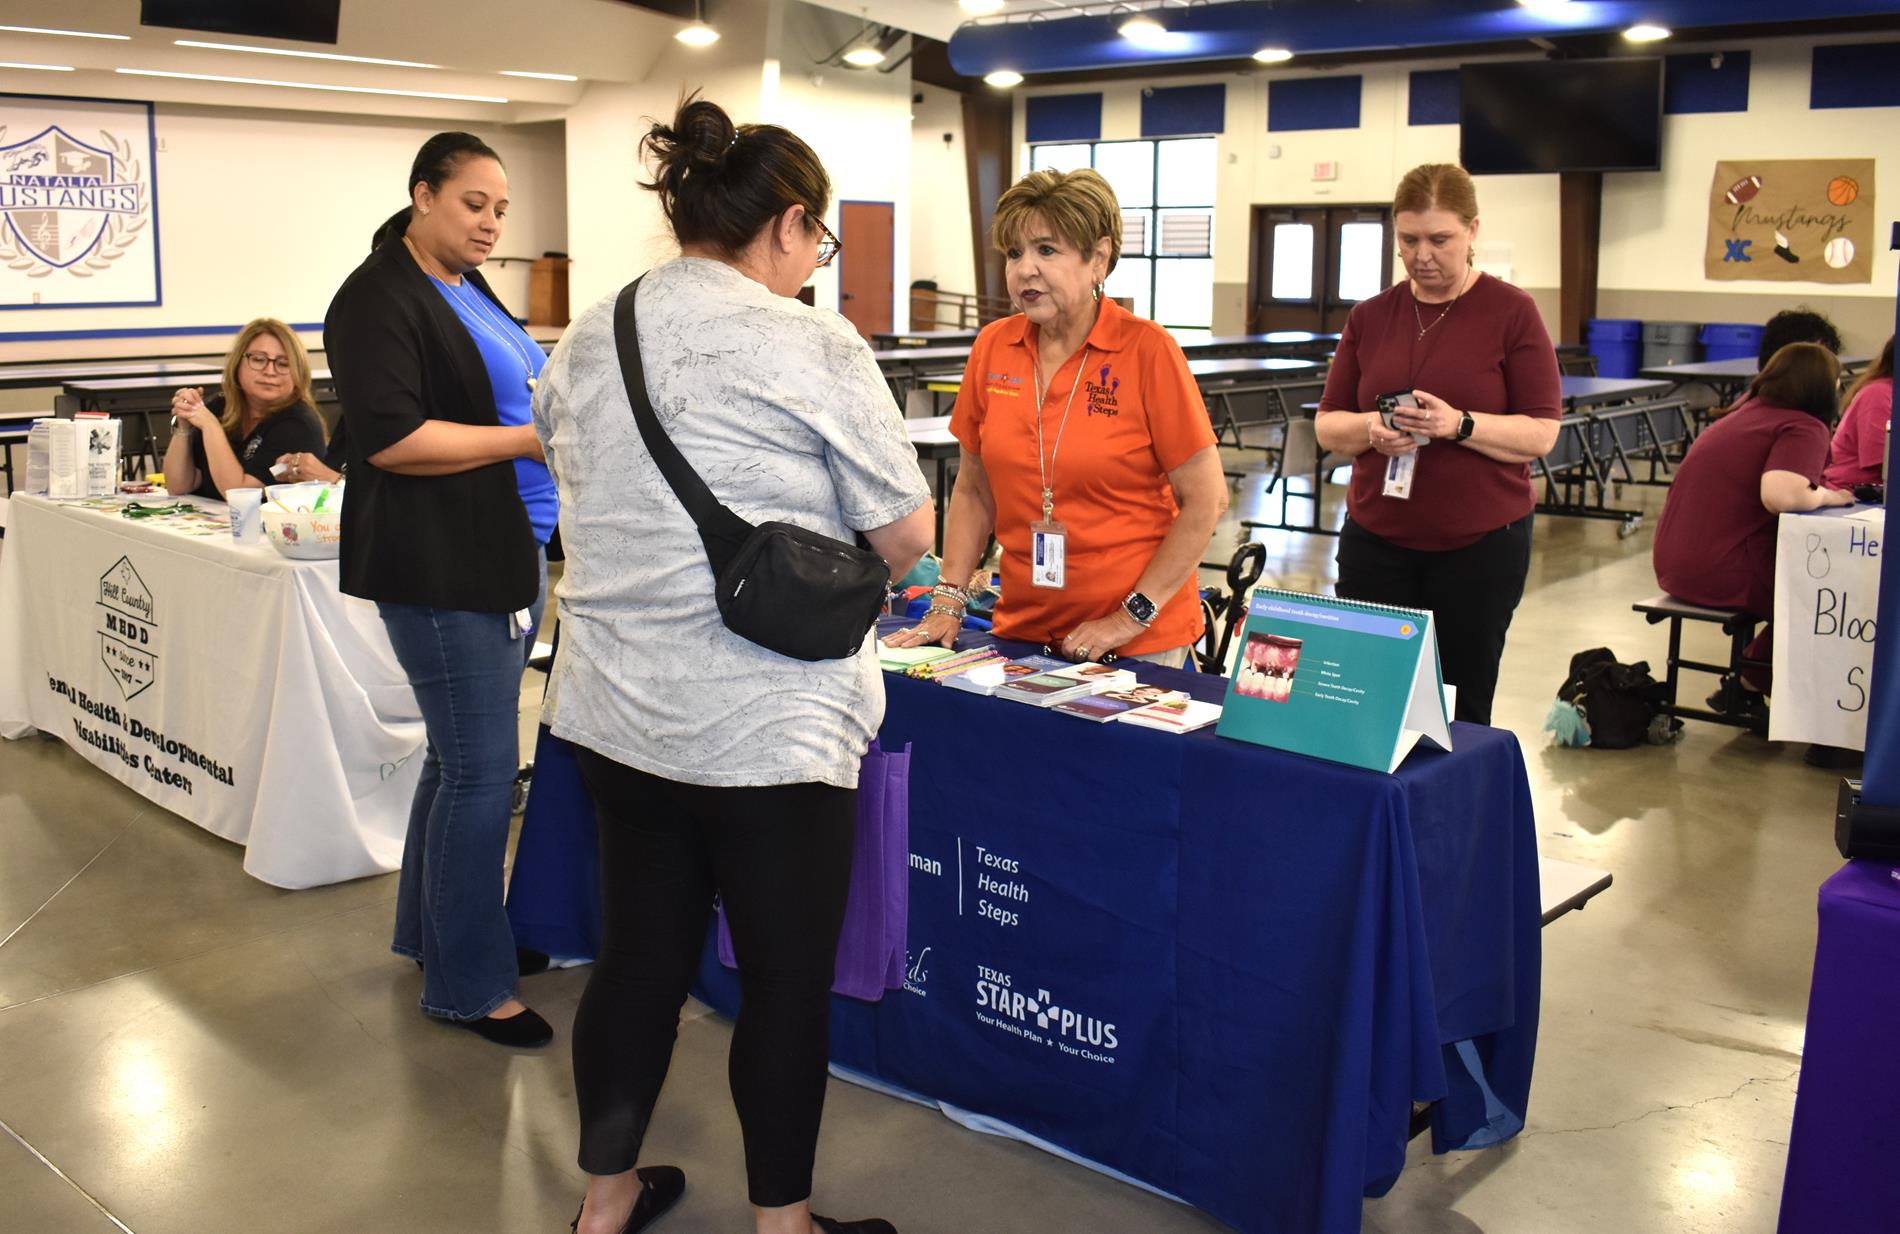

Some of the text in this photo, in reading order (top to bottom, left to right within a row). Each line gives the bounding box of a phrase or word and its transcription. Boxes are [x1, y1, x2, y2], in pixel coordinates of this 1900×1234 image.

[12, 175, 100, 188] NATALIA
[0, 186, 135, 210] USTANGS
[1732, 204, 1852, 243] Mustangs
[1723, 239, 1752, 263] XC
[1085, 381, 1110, 395] Texas
[1088, 392, 1118, 406] Health
[1093, 404, 1119, 417] Steps
[1850, 526, 1882, 557] He
[103, 581, 150, 619] Hill Country
[106, 613, 149, 645] MHDD
[1837, 666, 1866, 712] S
[78, 691, 121, 726] Health
[907, 852, 942, 876] man
[976, 846, 1019, 874] Texas
[978, 873, 1029, 903] Health
[978, 899, 1019, 926] Steps
[903, 982, 927, 997] Choice
[977, 965, 1012, 988] TEXAS
[976, 980, 1118, 1049] STAR PLUS
[976, 1011, 1115, 1064] Your Health Plan Your Choice
